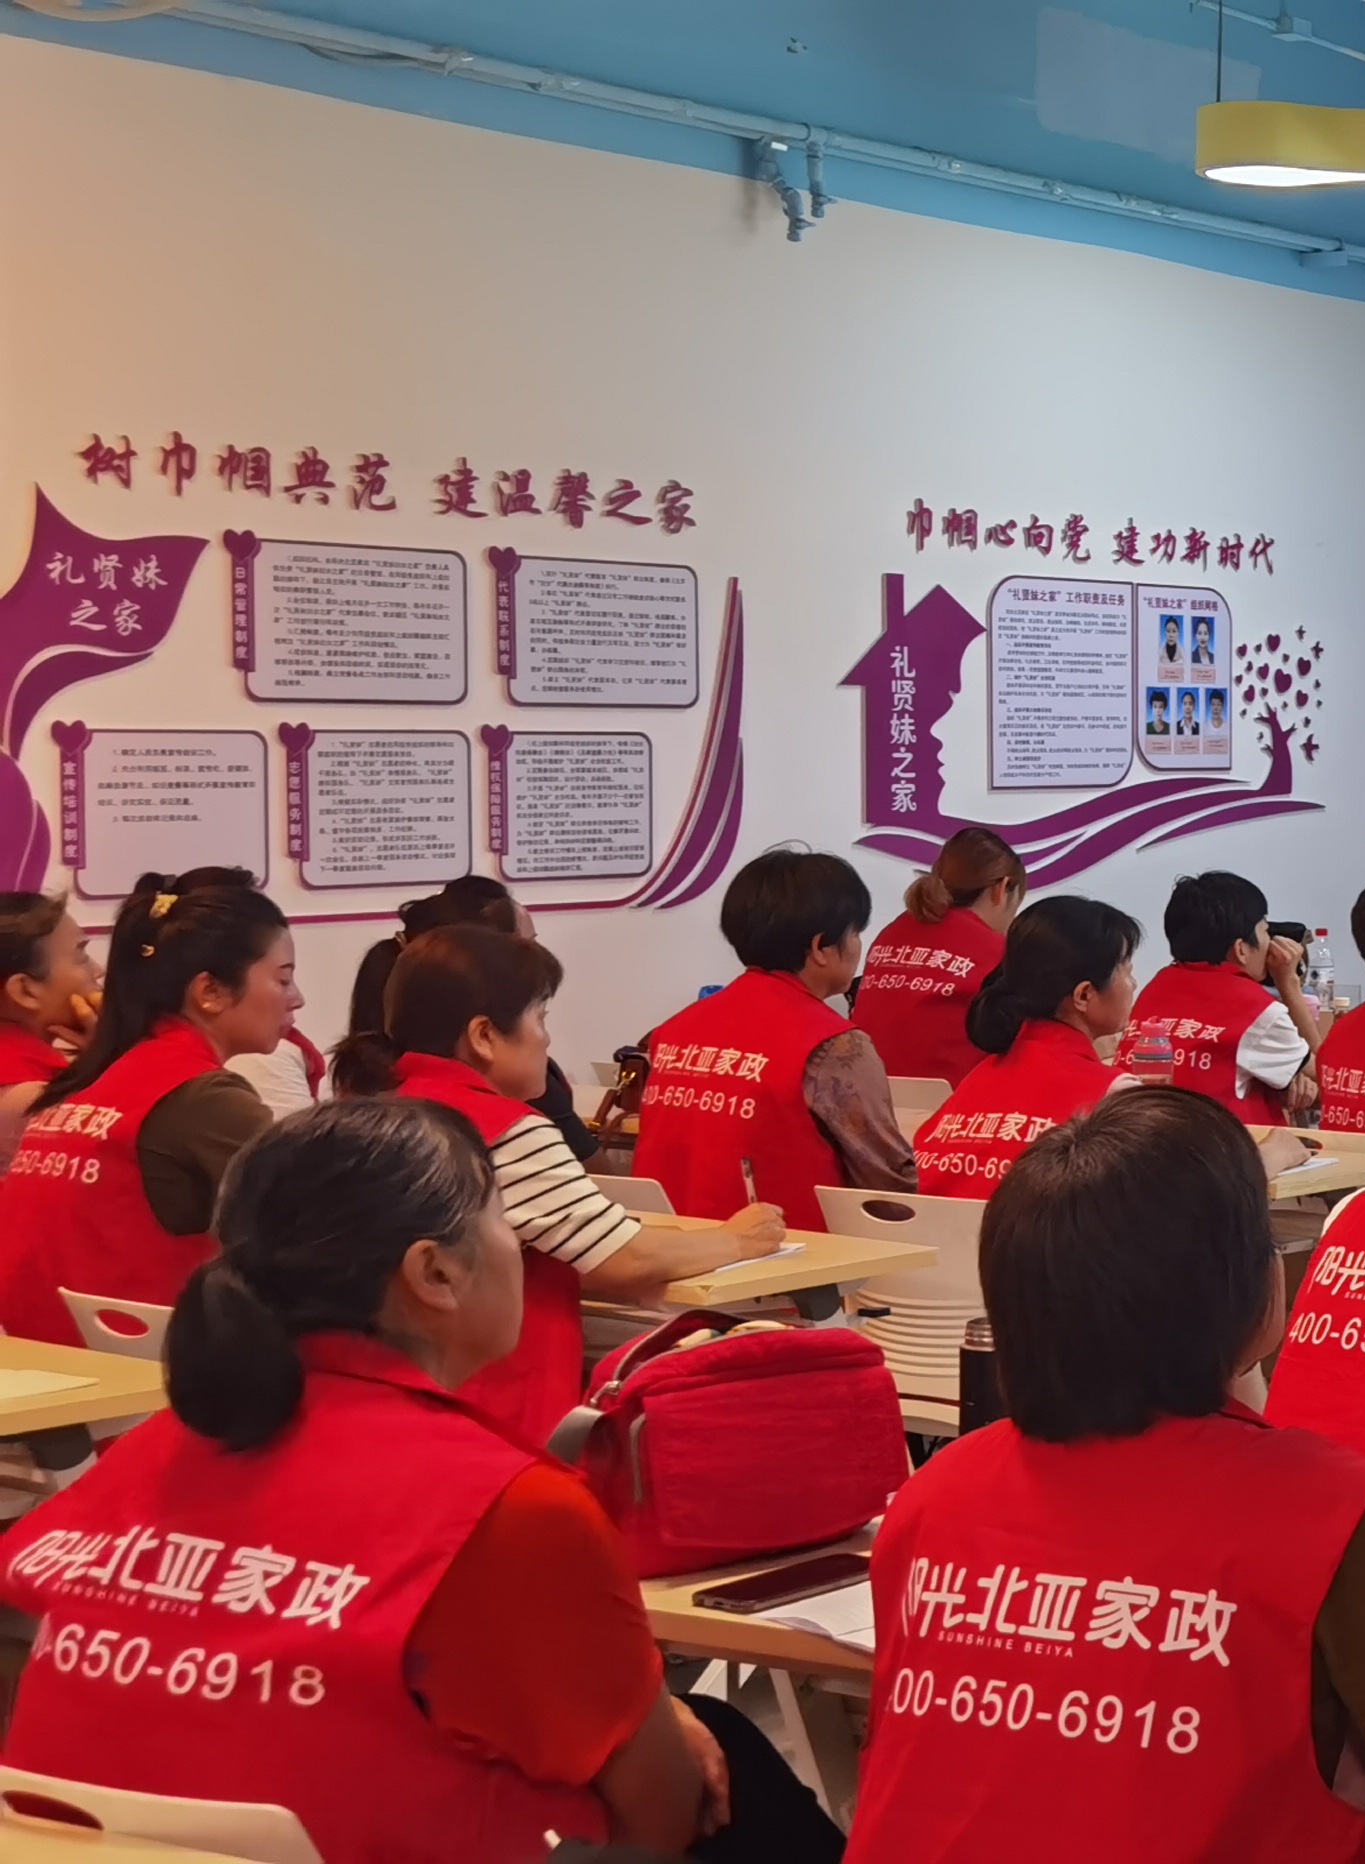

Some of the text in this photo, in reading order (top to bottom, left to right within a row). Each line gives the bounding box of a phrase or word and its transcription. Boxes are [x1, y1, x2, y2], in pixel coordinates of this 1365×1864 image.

[78, 432, 697, 534] 树巾帼典范 建温馨之家
[907, 498, 1276, 573] 巾帼心向党 建功新时代
[47, 553, 169, 589] 礼贤妹
[69, 599, 144, 635] 之家
[889, 646, 917, 813] 礼贤妹之家
[938, 1630, 1074, 1658] SUNSHINE BEIYA
